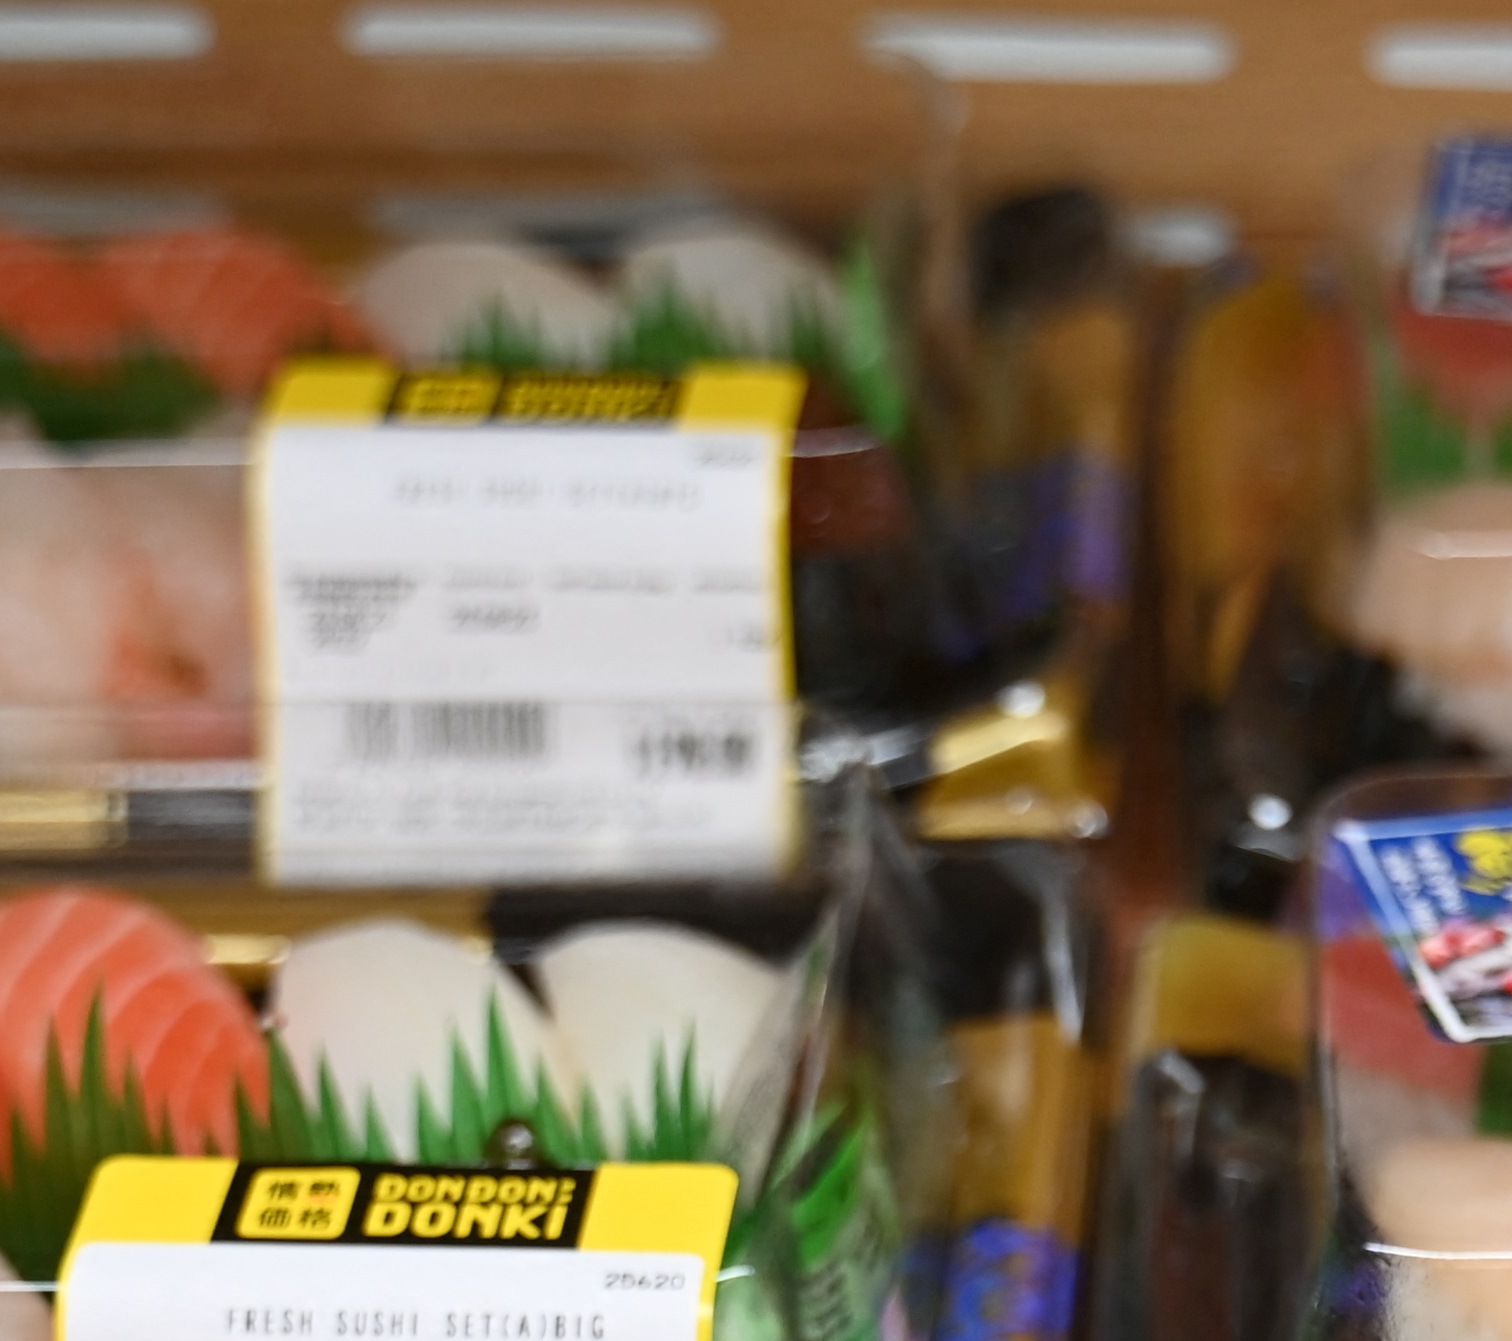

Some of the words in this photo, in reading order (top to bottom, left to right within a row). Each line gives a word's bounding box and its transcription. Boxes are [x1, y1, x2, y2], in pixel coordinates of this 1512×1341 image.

[604, 1272, 685, 1291] 25620
[226, 1306, 314, 1336] FRESH
[337, 1309, 419, 1338] SUSHI
